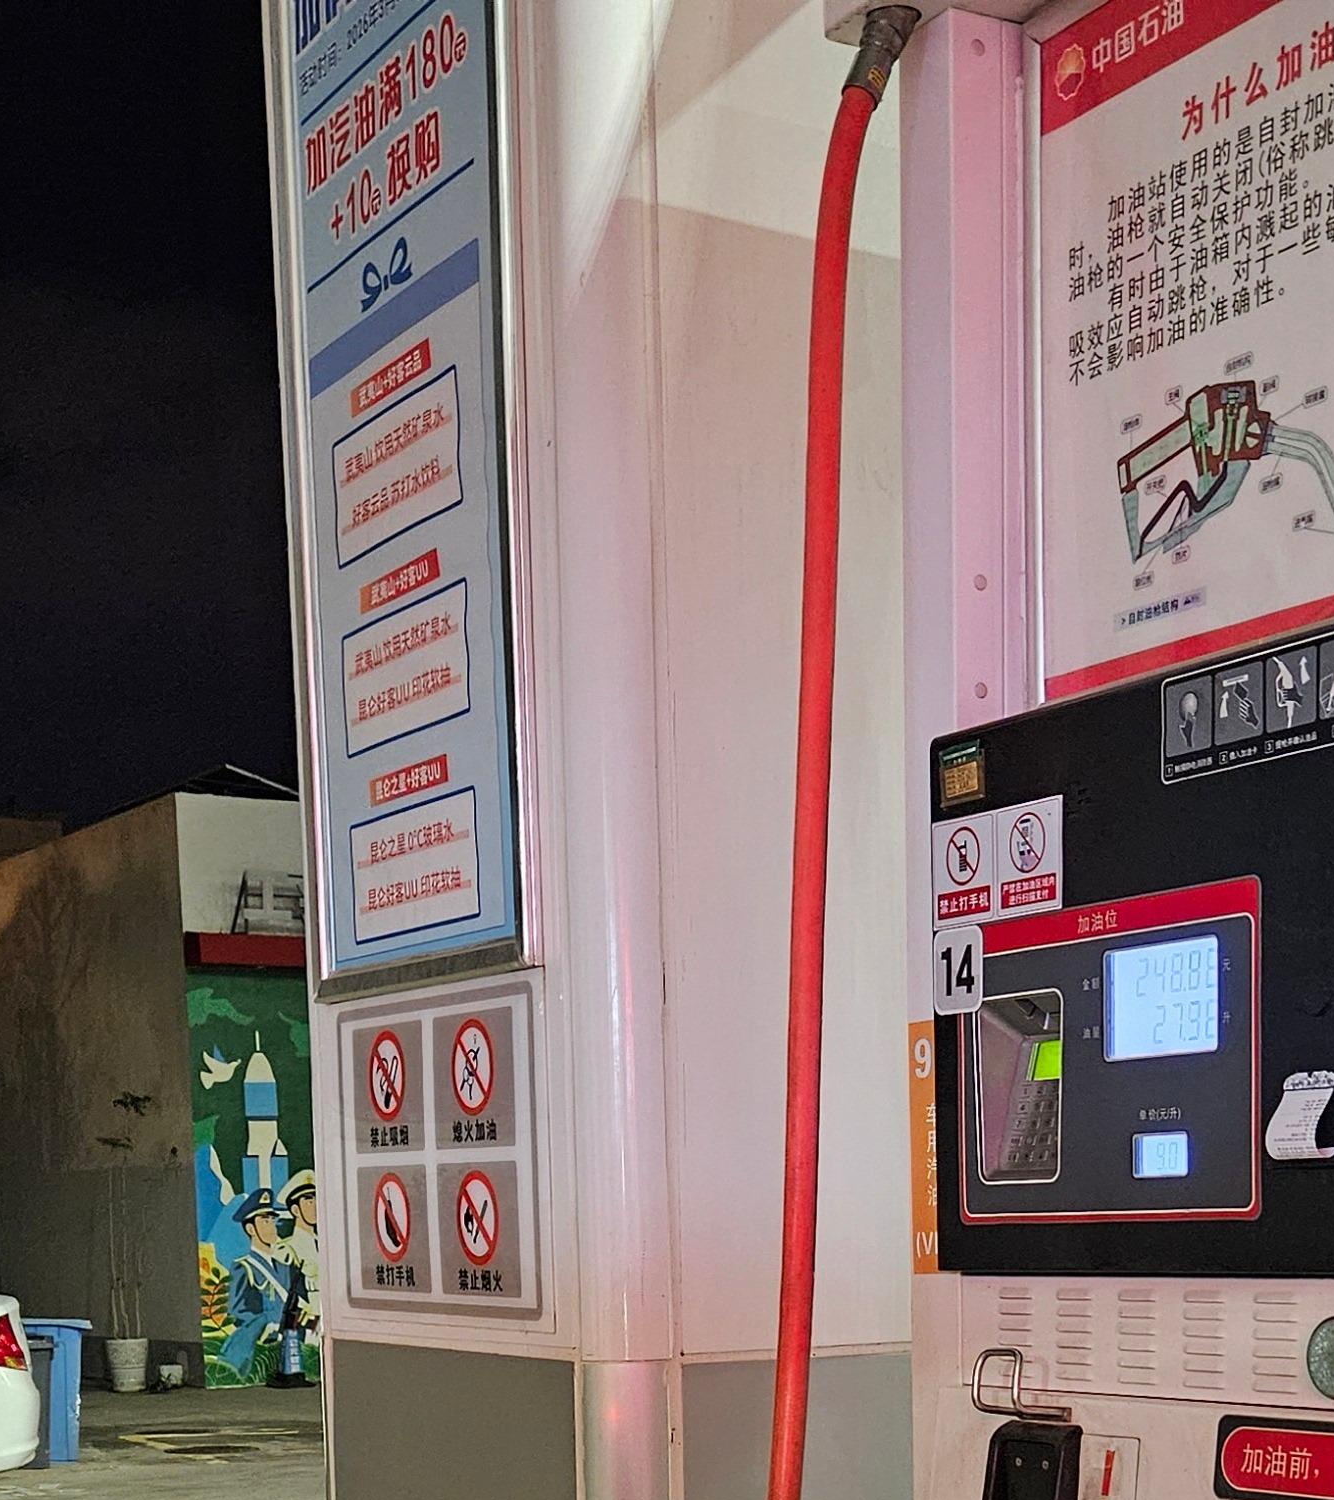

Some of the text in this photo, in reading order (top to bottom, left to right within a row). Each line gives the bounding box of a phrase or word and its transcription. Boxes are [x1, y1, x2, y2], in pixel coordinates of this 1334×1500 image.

[1092, 0, 1184, 73] 中国石油
[939, 892, 989, 915] 禁止打手机
[1077, 910, 1118, 935] 加油位
[940, 944, 975, 998] 14
[370, 1122, 409, 1147] 禁止吸烟
[452, 1119, 497, 1143] 熄火加油
[376, 1264, 416, 1288] 禁打手机
[458, 1268, 503, 1292] 禁止烟火
